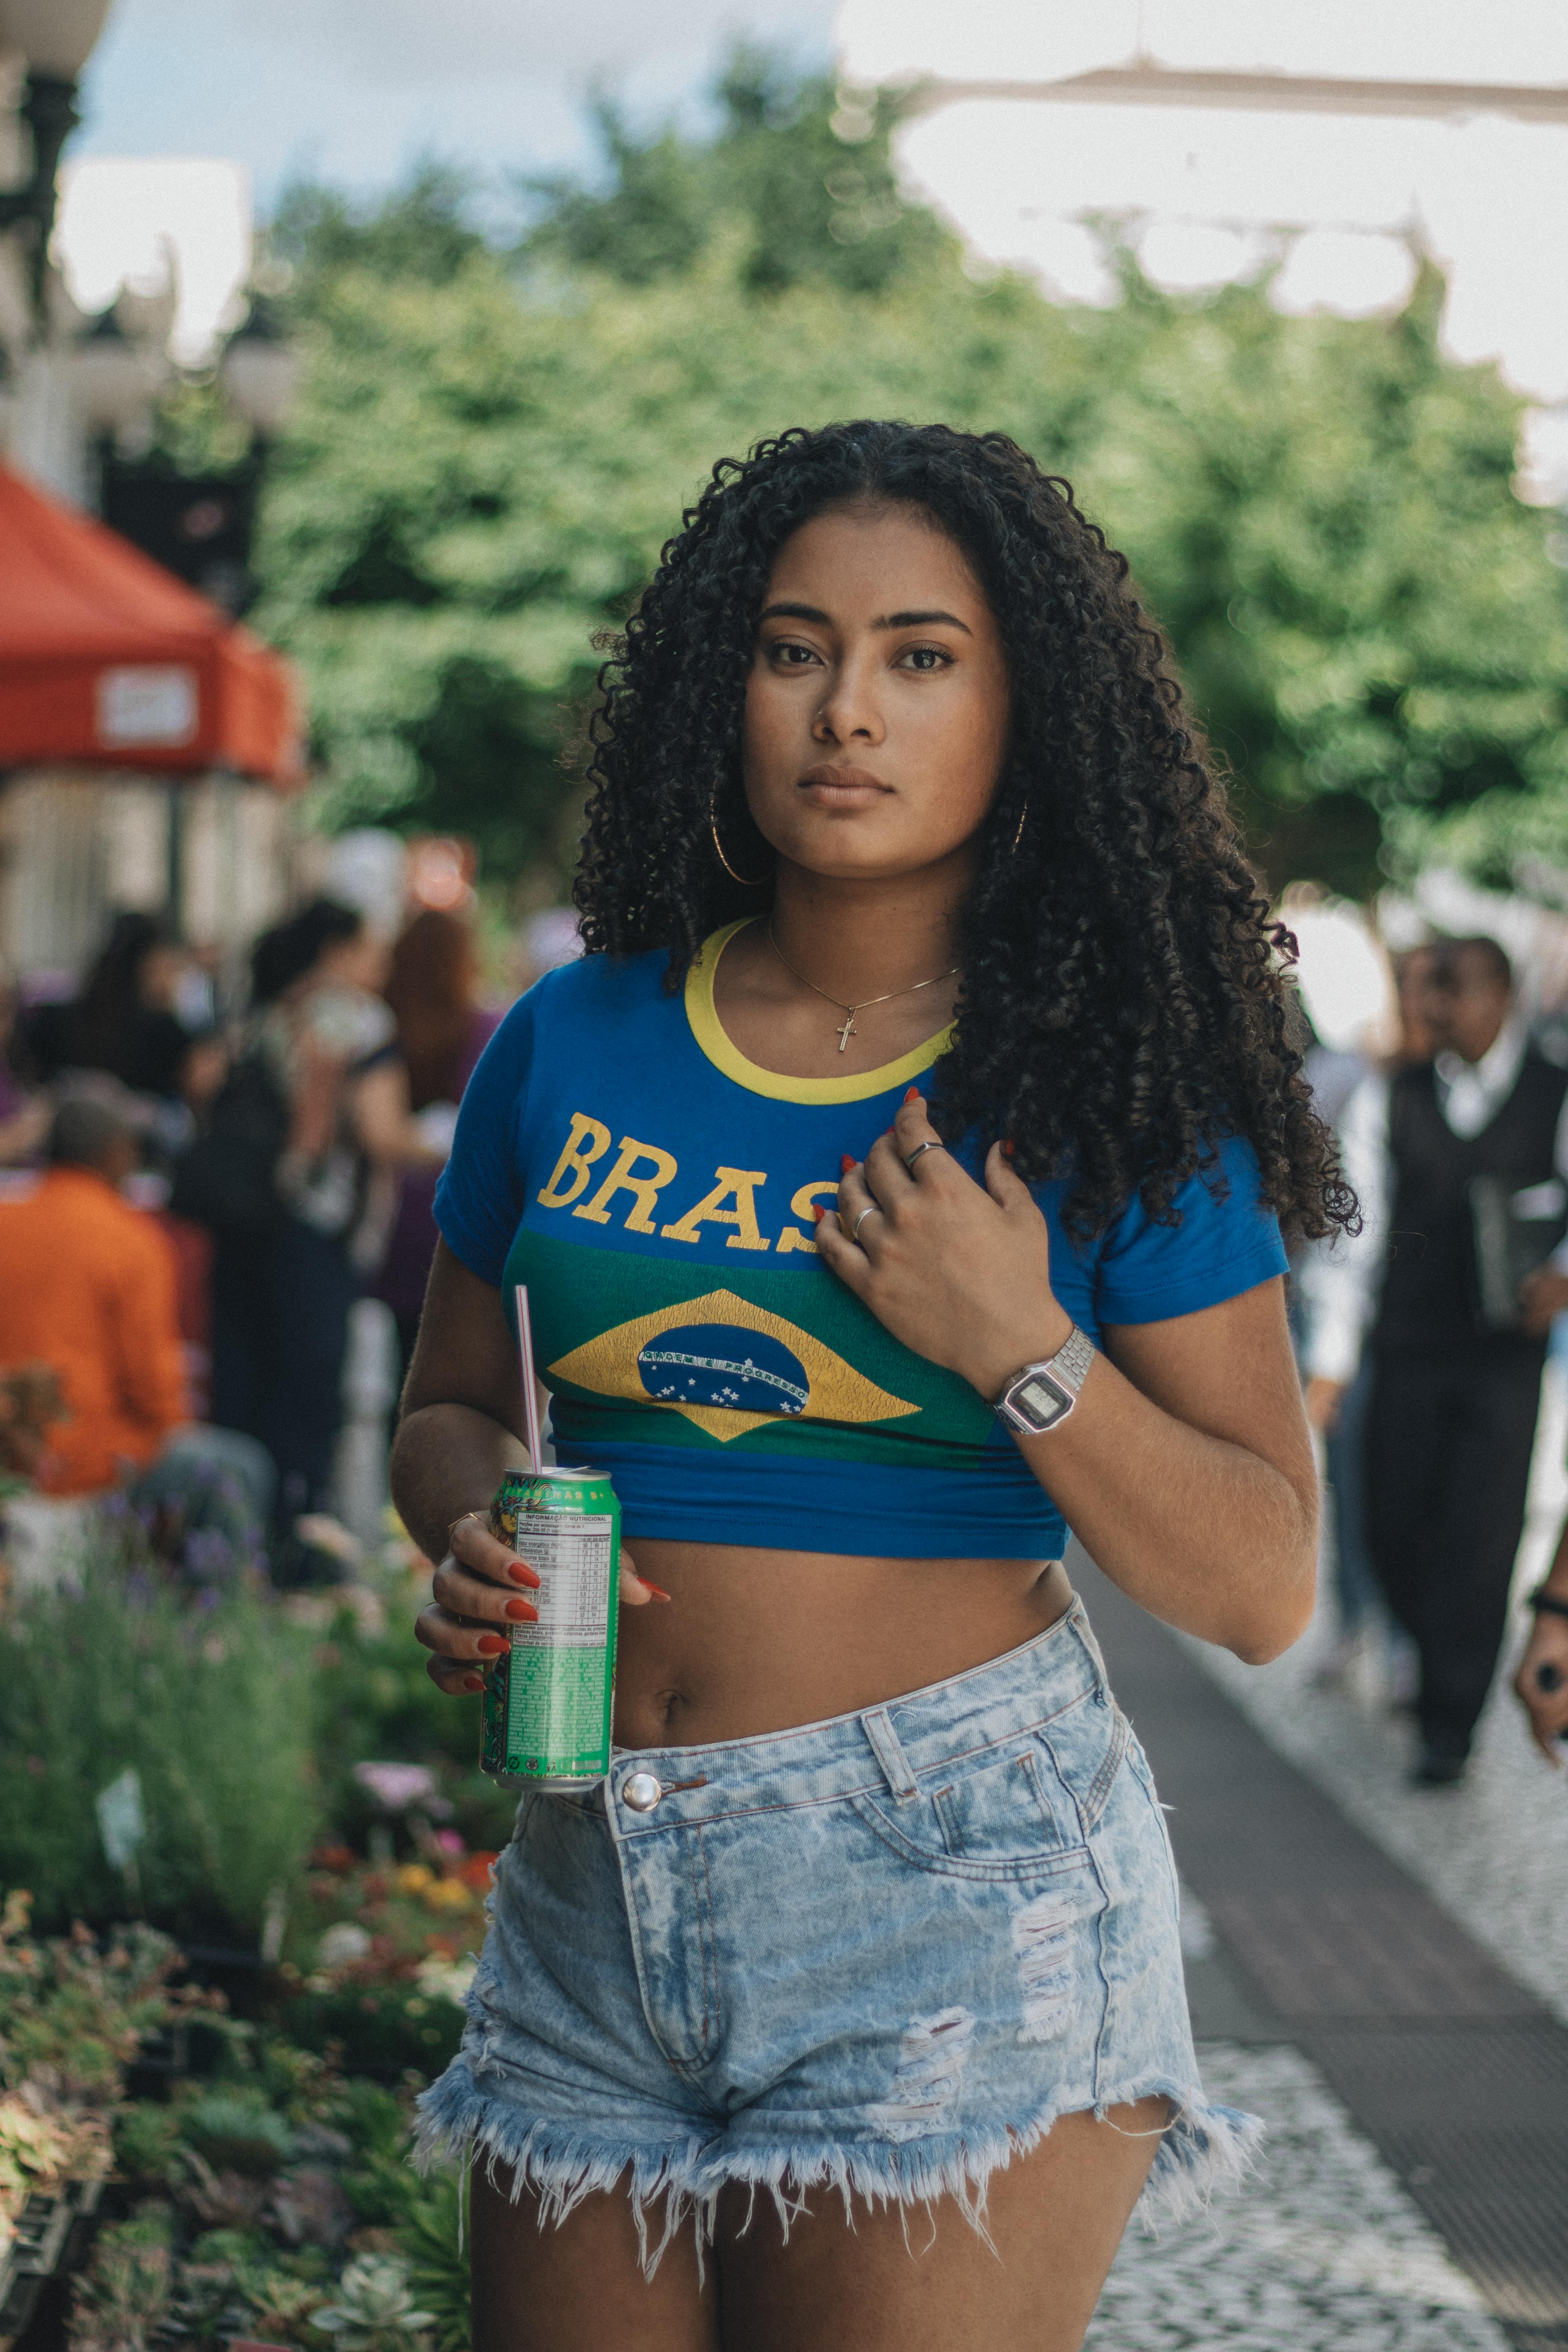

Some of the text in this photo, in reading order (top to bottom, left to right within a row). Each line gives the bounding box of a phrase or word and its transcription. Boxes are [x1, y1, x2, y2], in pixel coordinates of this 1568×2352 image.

[645, 1351, 806, 1399] ORDEM E PROGRESSO
[525, 1514, 567, 1522] INFORMAÇÃO
